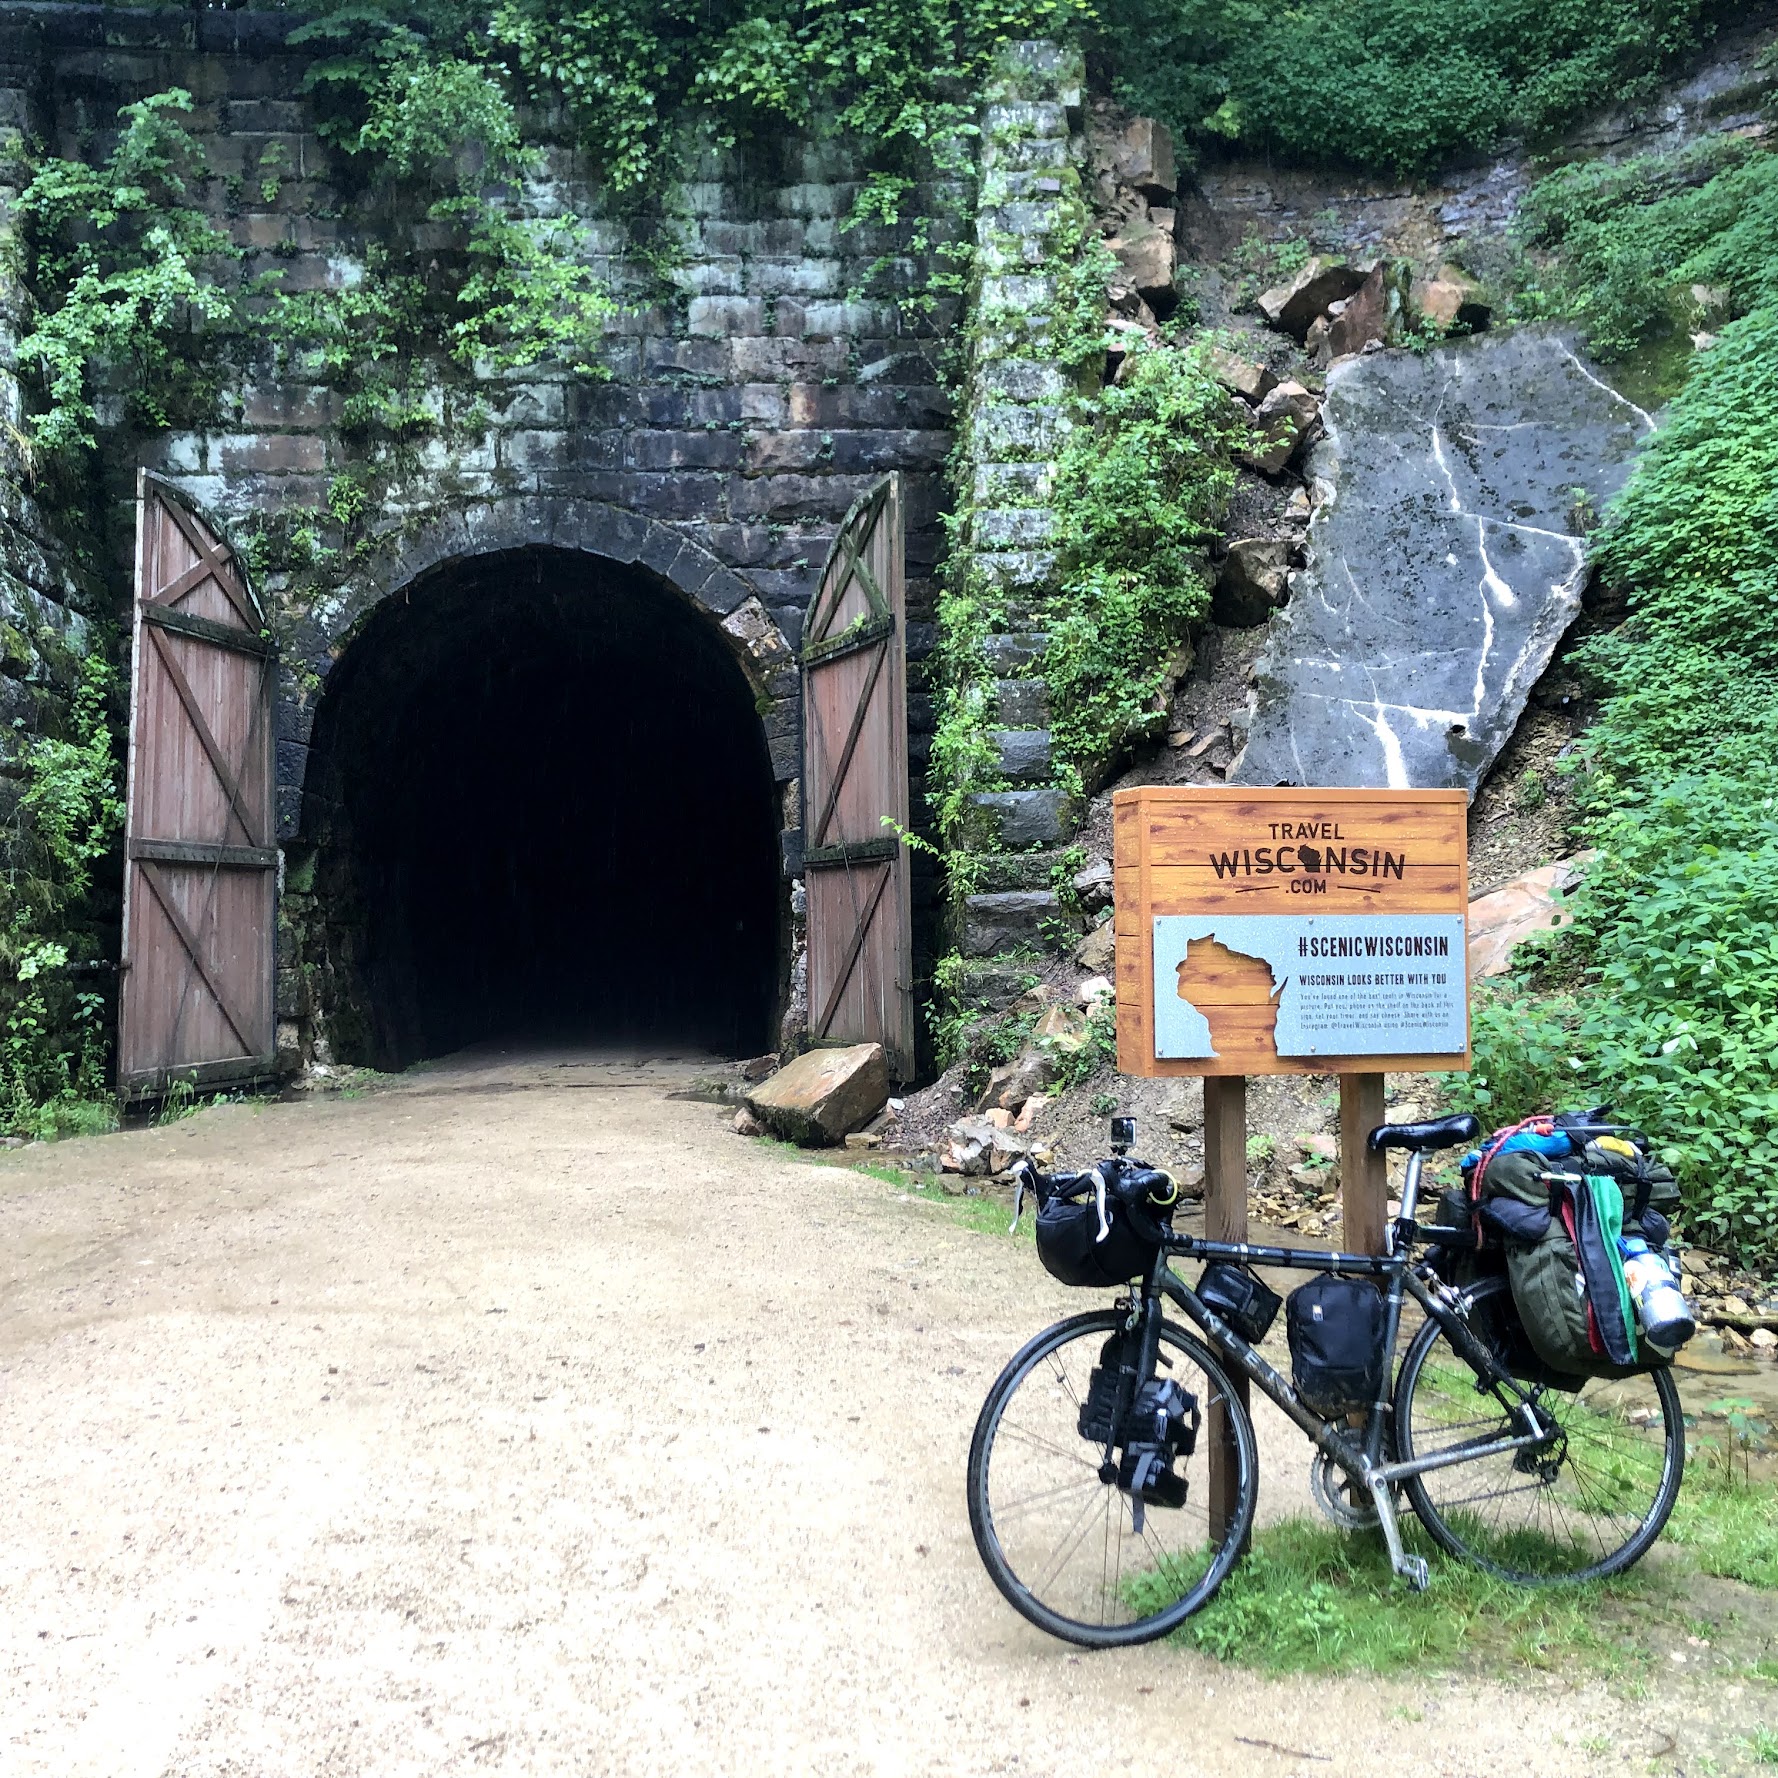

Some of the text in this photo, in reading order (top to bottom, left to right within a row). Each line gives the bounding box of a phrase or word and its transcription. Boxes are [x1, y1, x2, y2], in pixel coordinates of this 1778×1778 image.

[1268, 823, 1345, 840] TRAVEL
[1285, 879, 1327, 894] .COM
[1298, 936, 1448, 957] #SCENICWISCONSIN
[1299, 973, 1447, 986] WISCONSIN LOOKS BETTER WITH YOU
